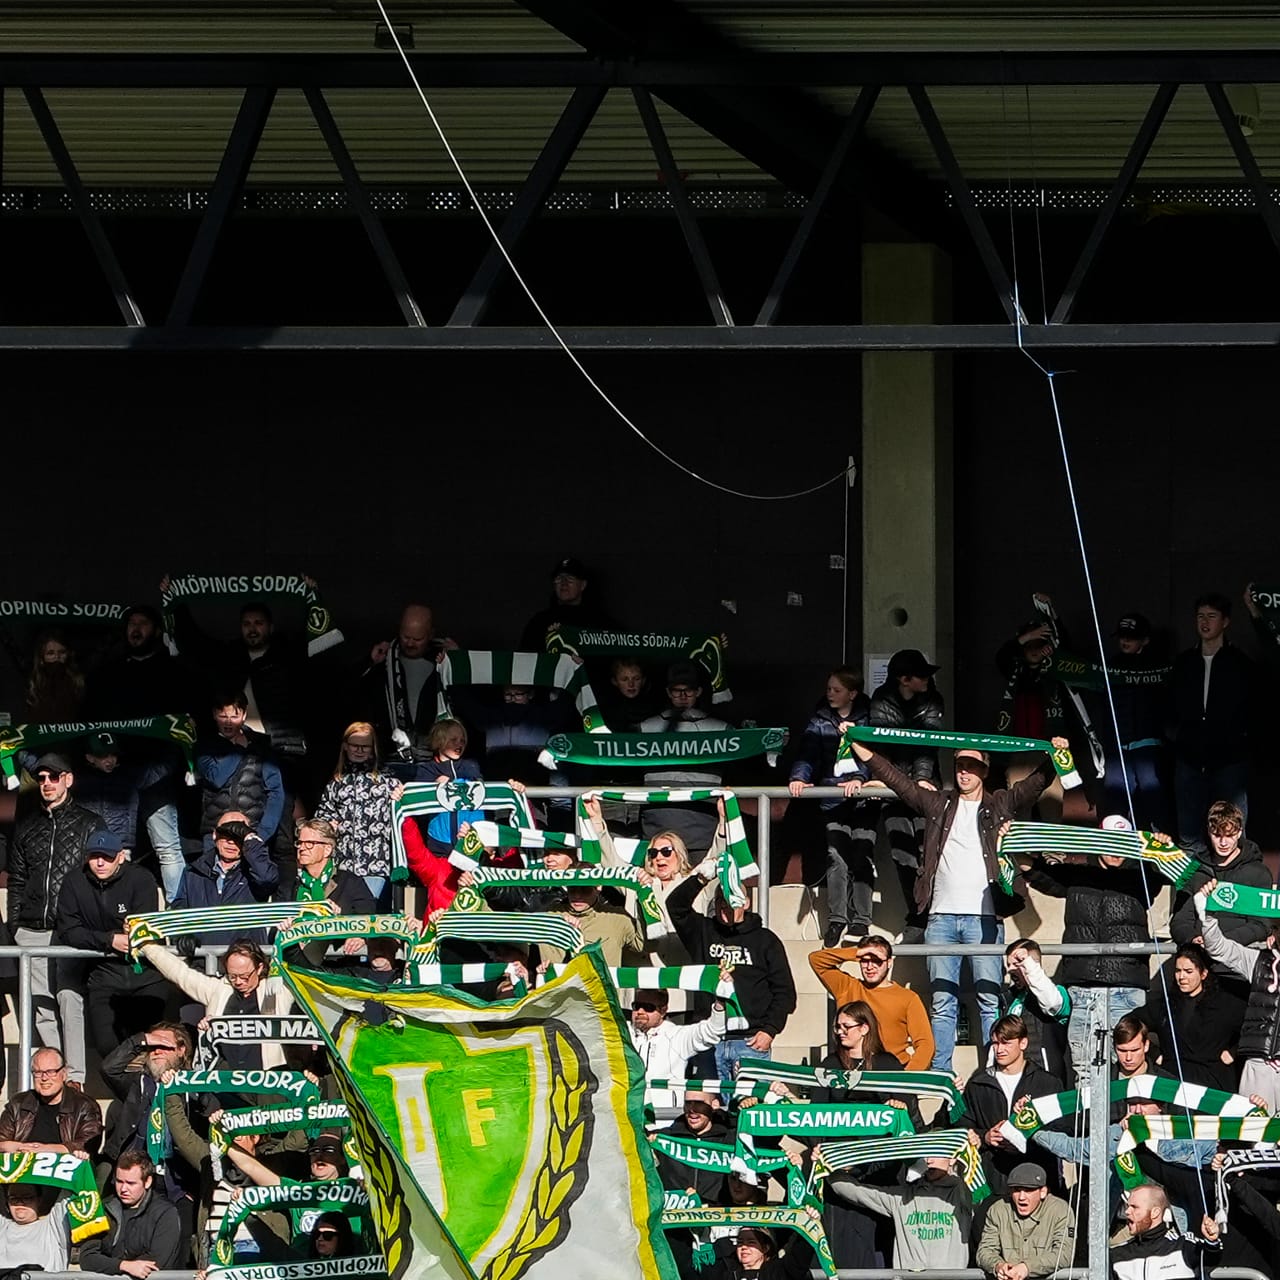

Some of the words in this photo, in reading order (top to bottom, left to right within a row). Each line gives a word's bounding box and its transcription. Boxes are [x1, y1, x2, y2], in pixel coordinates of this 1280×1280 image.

[577, 629, 641, 648] JÖNKÖPINGS
[642, 631, 677, 648] SÖDRA
[592, 735, 741, 759] TILLSAMMANS
[747, 1109, 895, 1128] TILLSAMMANS
[32, 1152, 81, 1183] 22
